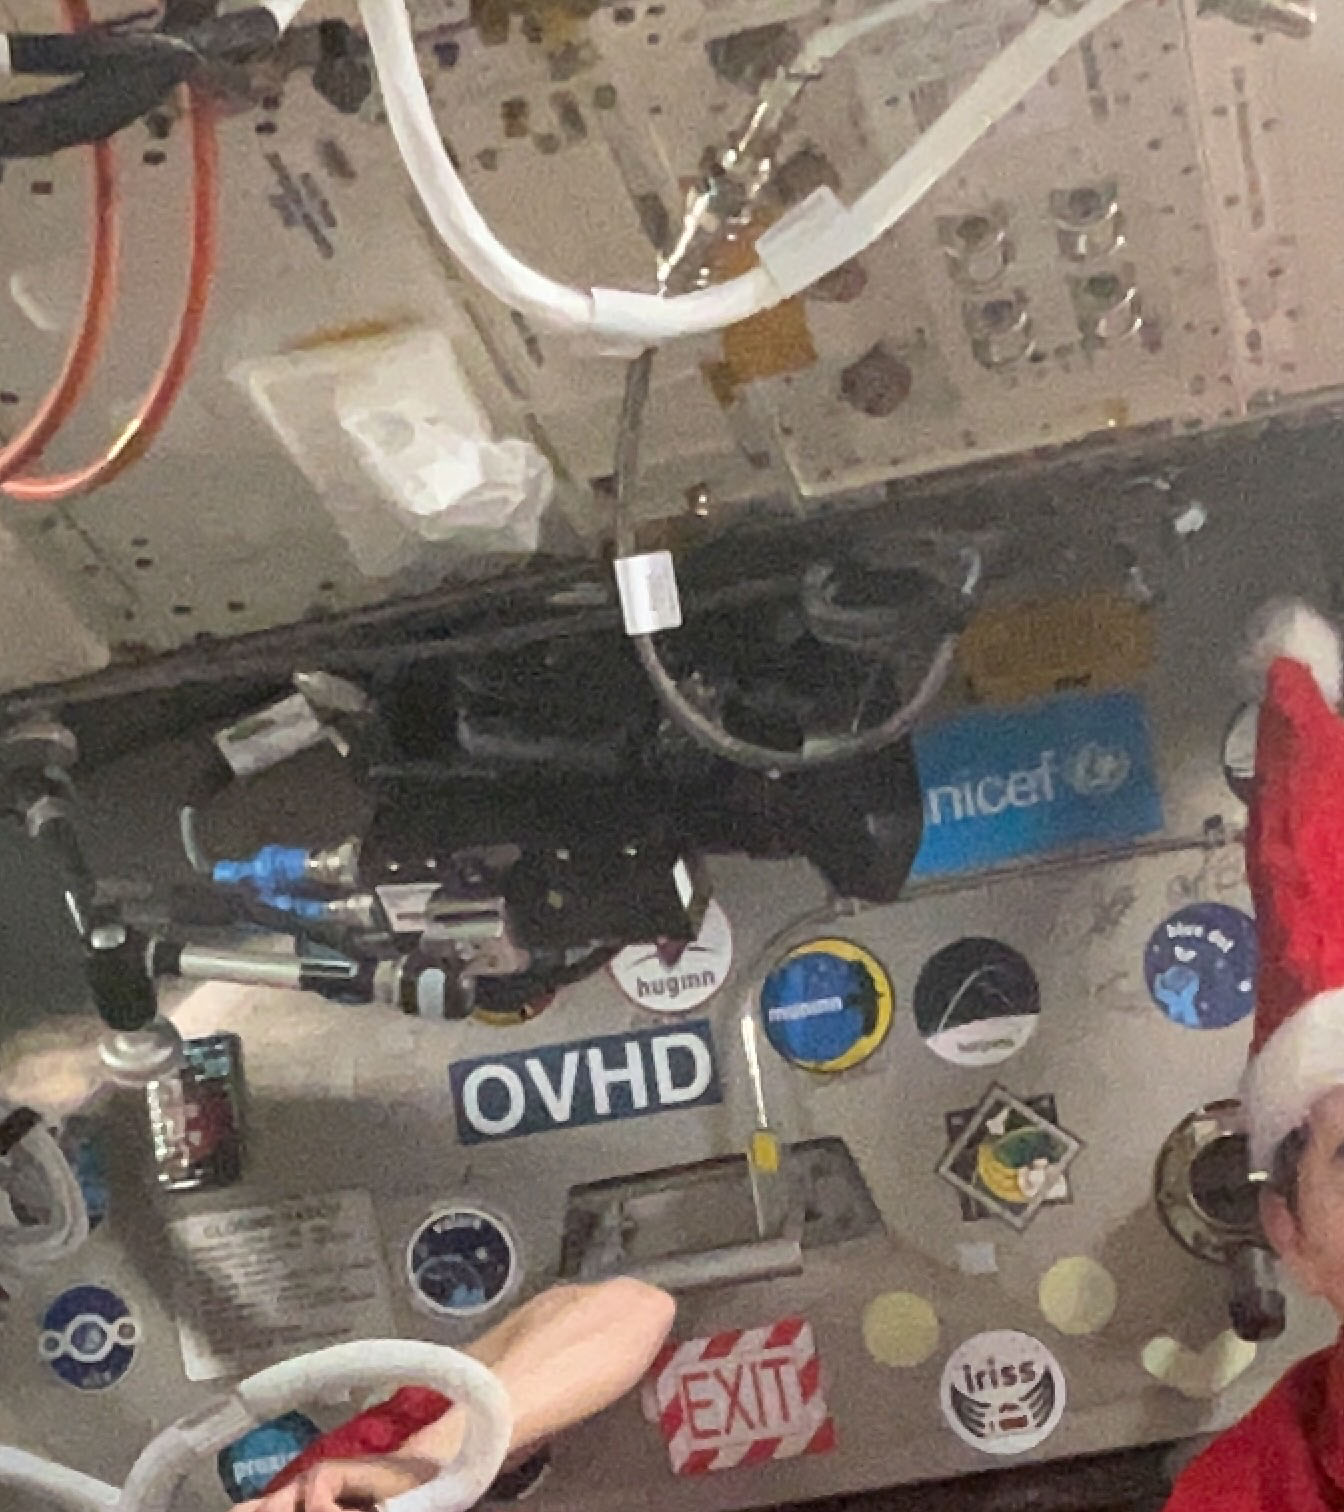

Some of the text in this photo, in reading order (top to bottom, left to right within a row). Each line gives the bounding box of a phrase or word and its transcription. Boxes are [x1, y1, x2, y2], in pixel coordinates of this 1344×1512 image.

[927, 750, 1055, 825] nicef
[462, 1033, 712, 1136] OVHD
[682, 1357, 790, 1439] EXIT
[962, 1355, 1036, 1394] iriss
